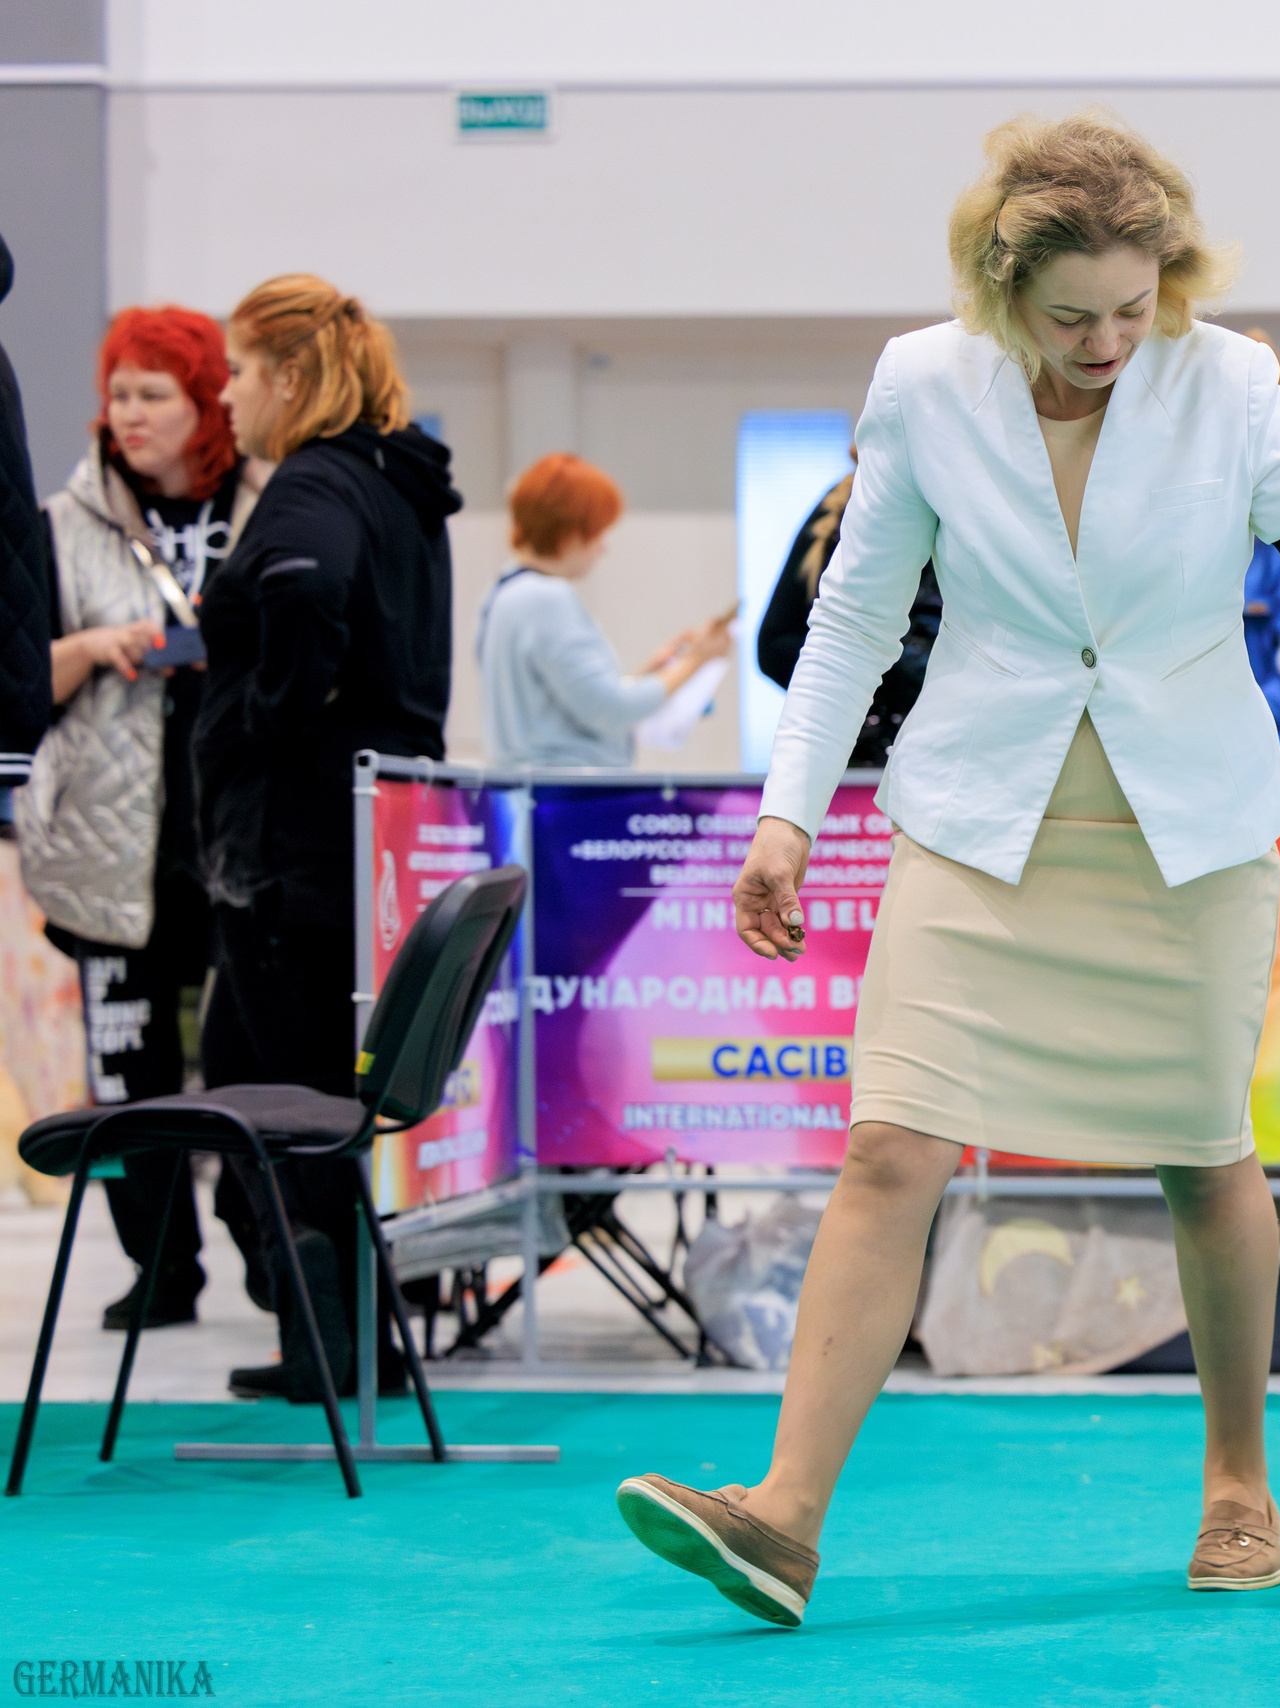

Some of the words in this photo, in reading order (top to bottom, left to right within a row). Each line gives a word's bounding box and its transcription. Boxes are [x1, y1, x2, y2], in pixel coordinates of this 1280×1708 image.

[528, 974, 816, 1015] ДУНАРОДНАЯ
[711, 1044, 848, 1079] CACIB
[623, 1103, 847, 1132] INTERNATIONAL
